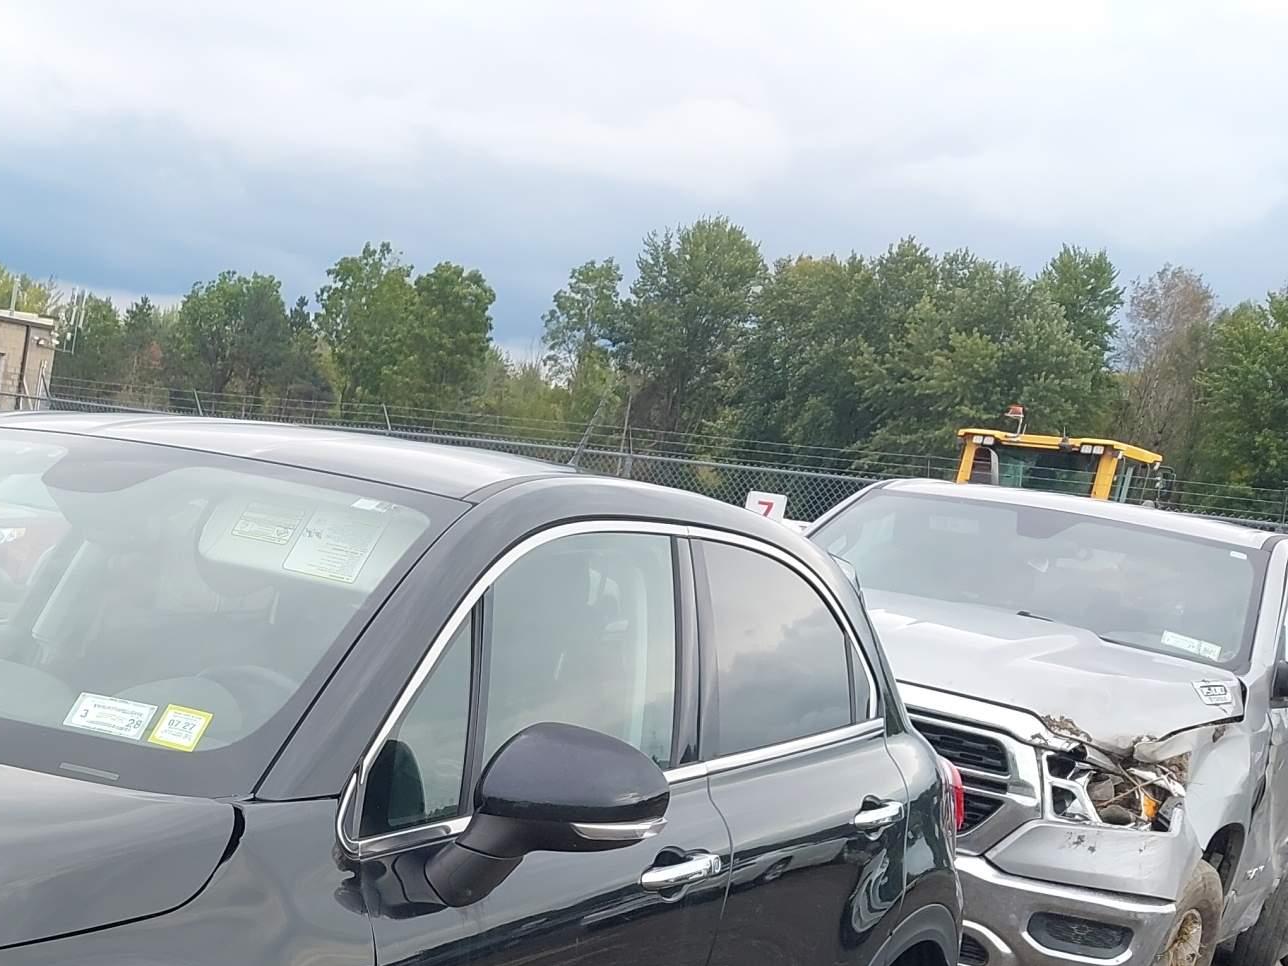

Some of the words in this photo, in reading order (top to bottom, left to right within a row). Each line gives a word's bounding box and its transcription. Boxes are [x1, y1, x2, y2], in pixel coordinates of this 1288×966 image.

[758, 500, 774, 517] 7
[79, 708, 89, 718] 3
[124, 717, 143, 729] 28
